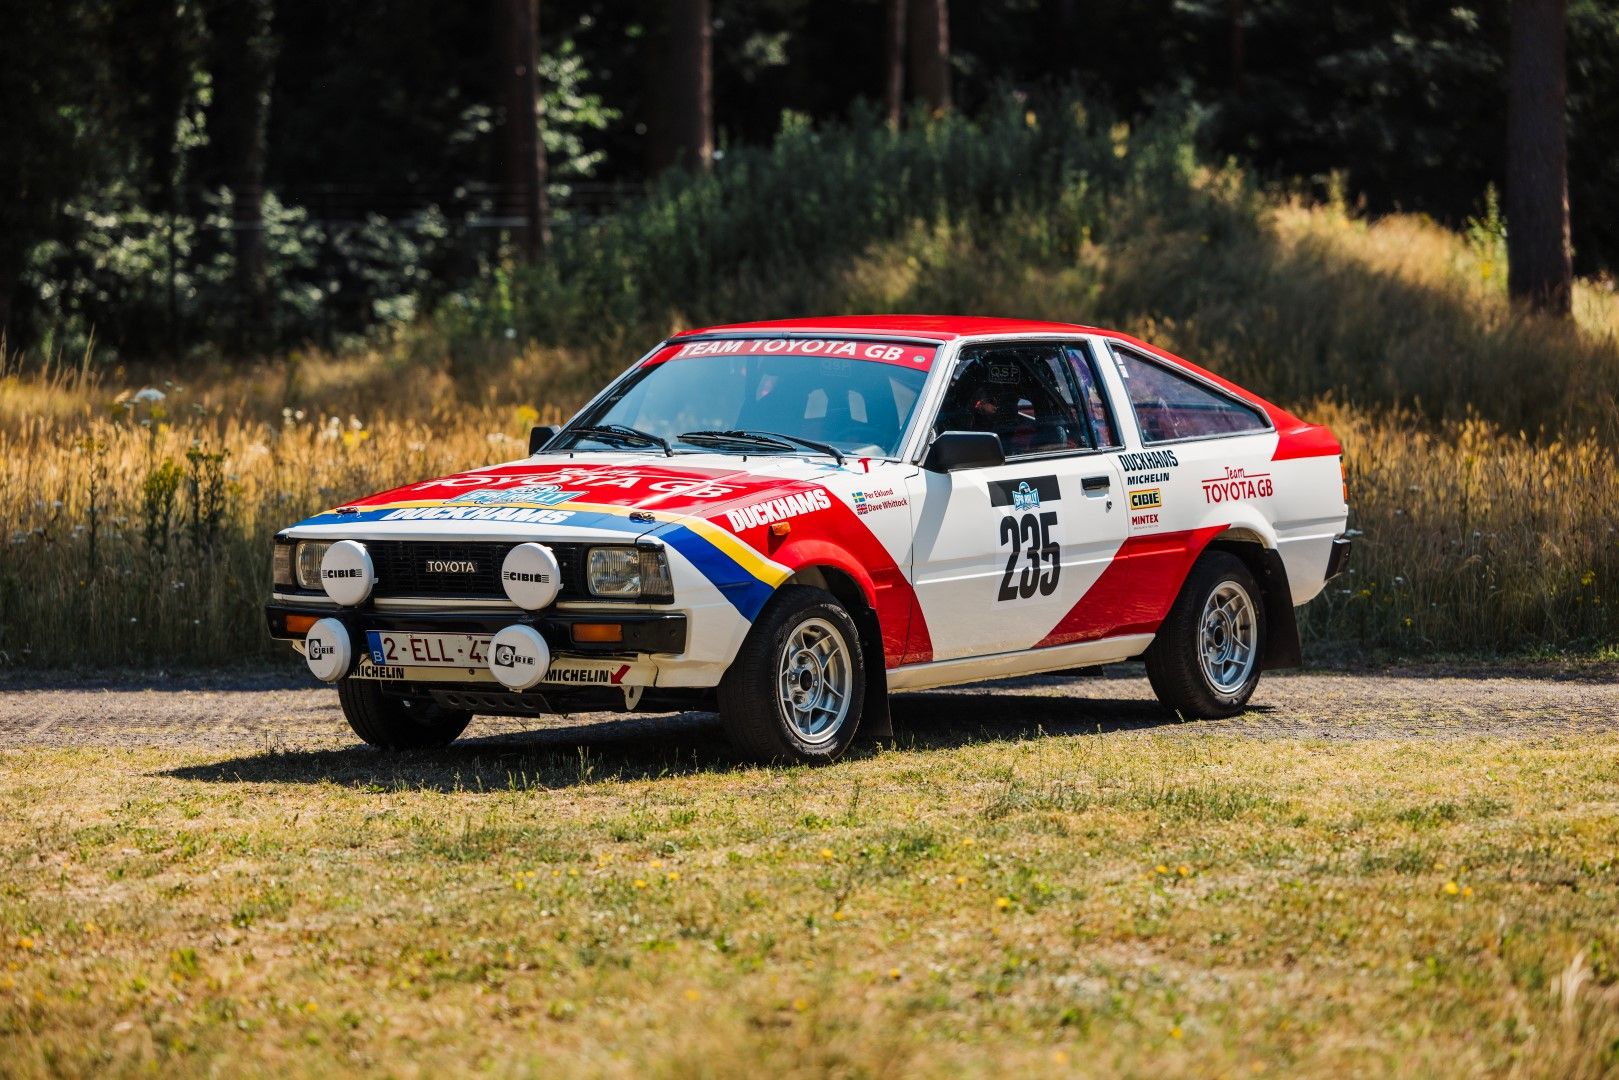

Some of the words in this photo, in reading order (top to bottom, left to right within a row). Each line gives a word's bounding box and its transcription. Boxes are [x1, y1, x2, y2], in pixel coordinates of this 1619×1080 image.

[678, 340, 744, 357] TEAM
[750, 339, 858, 356] TOYOTA
[864, 344, 904, 361] GB
[1117, 450, 1179, 472] DUCKHAMS
[1127, 473, 1170, 485] MICHELIN
[1224, 466, 1245, 479] Team
[412, 473, 638, 490] TOYOTA
[648, 480, 733, 498] GB
[1202, 481, 1257, 503] TOYOTA
[1257, 479, 1273, 497] GB
[874, 488, 894, 498] Eklund
[726, 488, 832, 533] DUCKHAMS
[867, 503, 883, 512] Dave
[378, 507, 577, 524] DUCKHAMS
[1131, 513, 1159, 526] MINTEX
[997, 511, 1061, 602] 235
[427, 560, 476, 573] TOYOTA
[373, 650, 383, 663] B
[545, 669, 609, 682] MICHELIN
